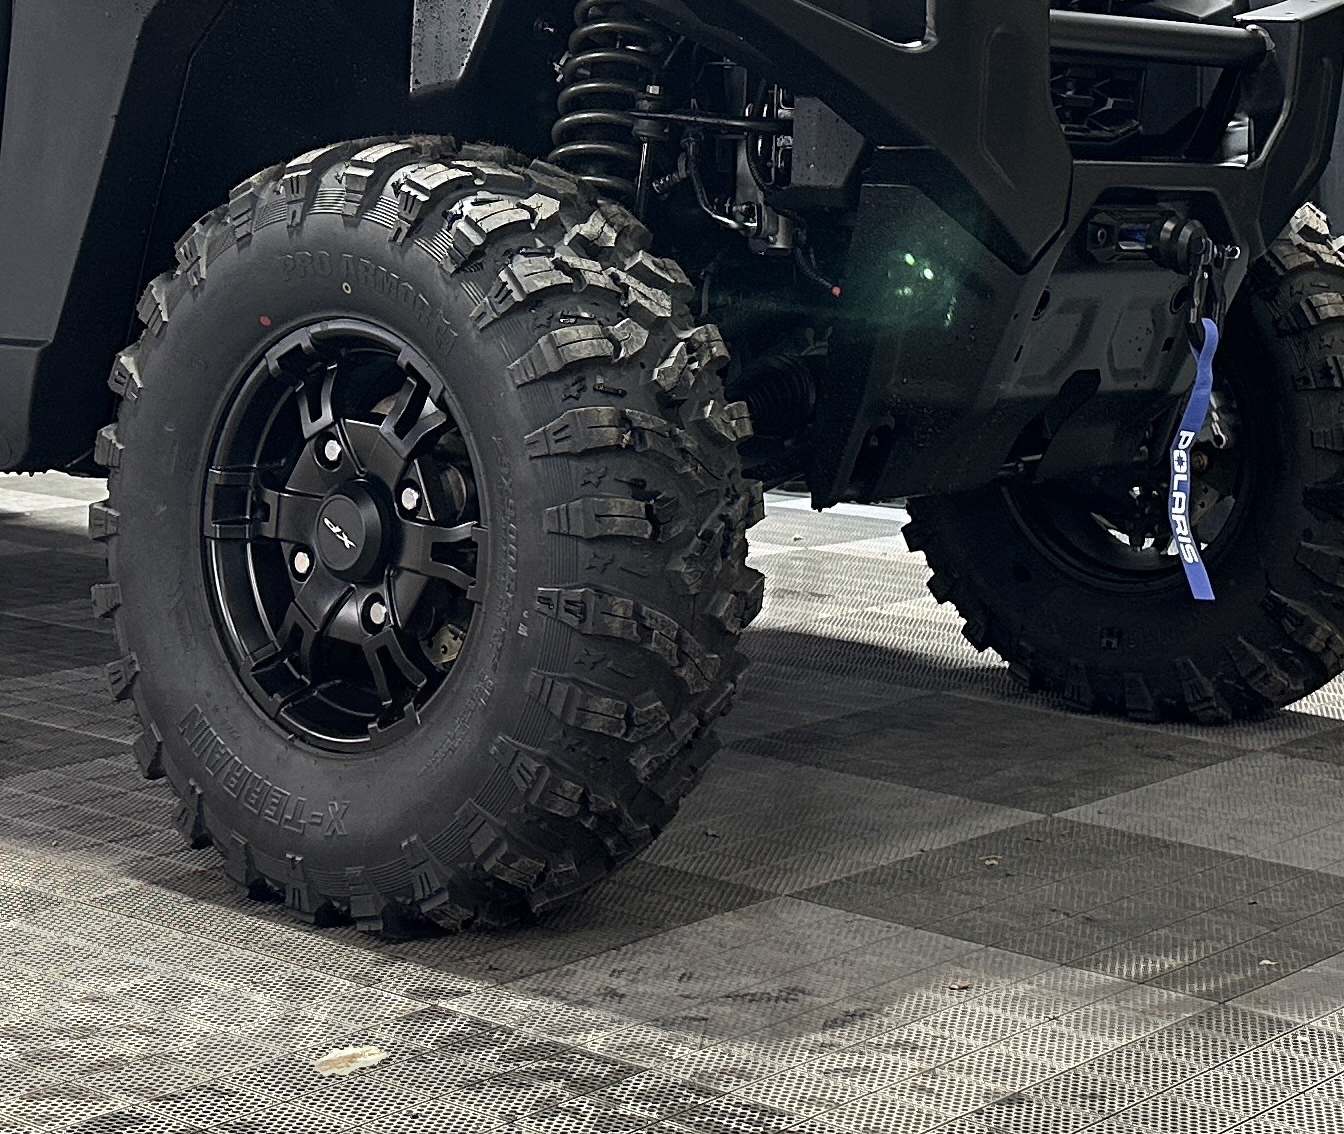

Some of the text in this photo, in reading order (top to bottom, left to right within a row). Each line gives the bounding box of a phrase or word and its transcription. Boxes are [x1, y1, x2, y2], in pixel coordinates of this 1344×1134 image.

[323, 517, 357, 549] XP
[1170, 429, 1200, 565] POLARIS
[177, 702, 353, 839] X-TERRAIN
